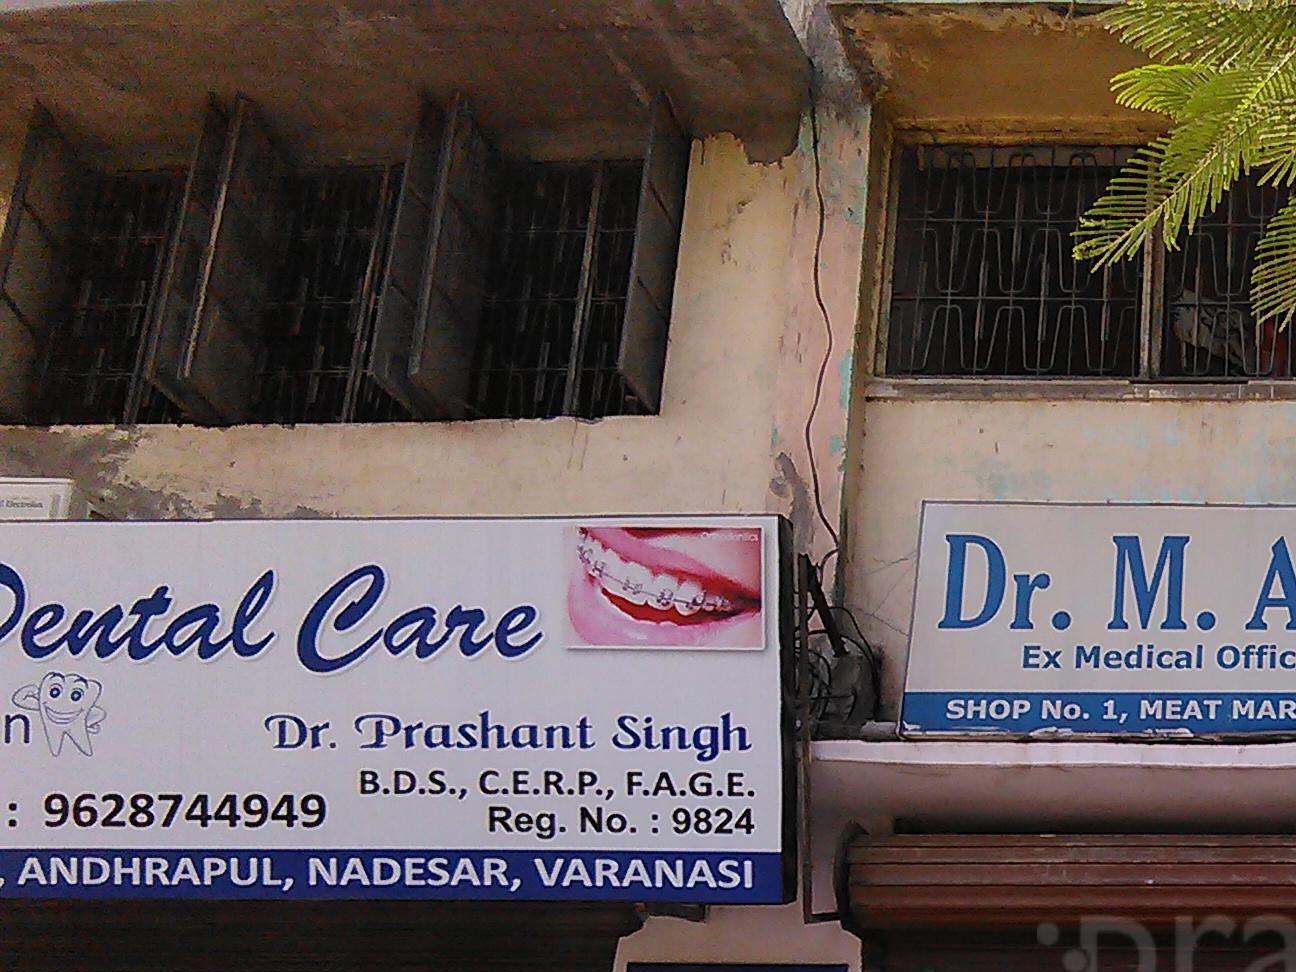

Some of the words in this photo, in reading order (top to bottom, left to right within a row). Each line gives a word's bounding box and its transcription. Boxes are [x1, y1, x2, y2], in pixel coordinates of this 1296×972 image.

[937, 533, 1072, 631] Dr.
[1107, 535, 1217, 631] M.
[296, 563, 543, 674] Care
[1021, 645, 1063, 669] Ex
[1074, 644, 1203, 670] Medical
[945, 699, 1032, 720] SHOP
[1041, 699, 1090, 720] No.
[1102, 699, 1128, 724] 1,
[1139, 699, 1222, 720] MEAT
[264, 713, 337, 750] Dr.
[354, 710, 596, 750] Prashant
[611, 711, 753, 763] Singh
[359, 770, 468, 800] B.D.S.,
[478, 770, 614, 801] C.E.R.P.,
[626, 771, 756, 798] F.A.G.E.
[43, 793, 327, 829] 9628744949
[487, 805, 567, 840] Reg.
[579, 806, 637, 834] No.
[671, 807, 755, 835] 9824
[17, 856, 294, 892] ANDHRAPUL,
[307, 857, 522, 892] NADESAR,
[533, 858, 753, 889] VARANASI
